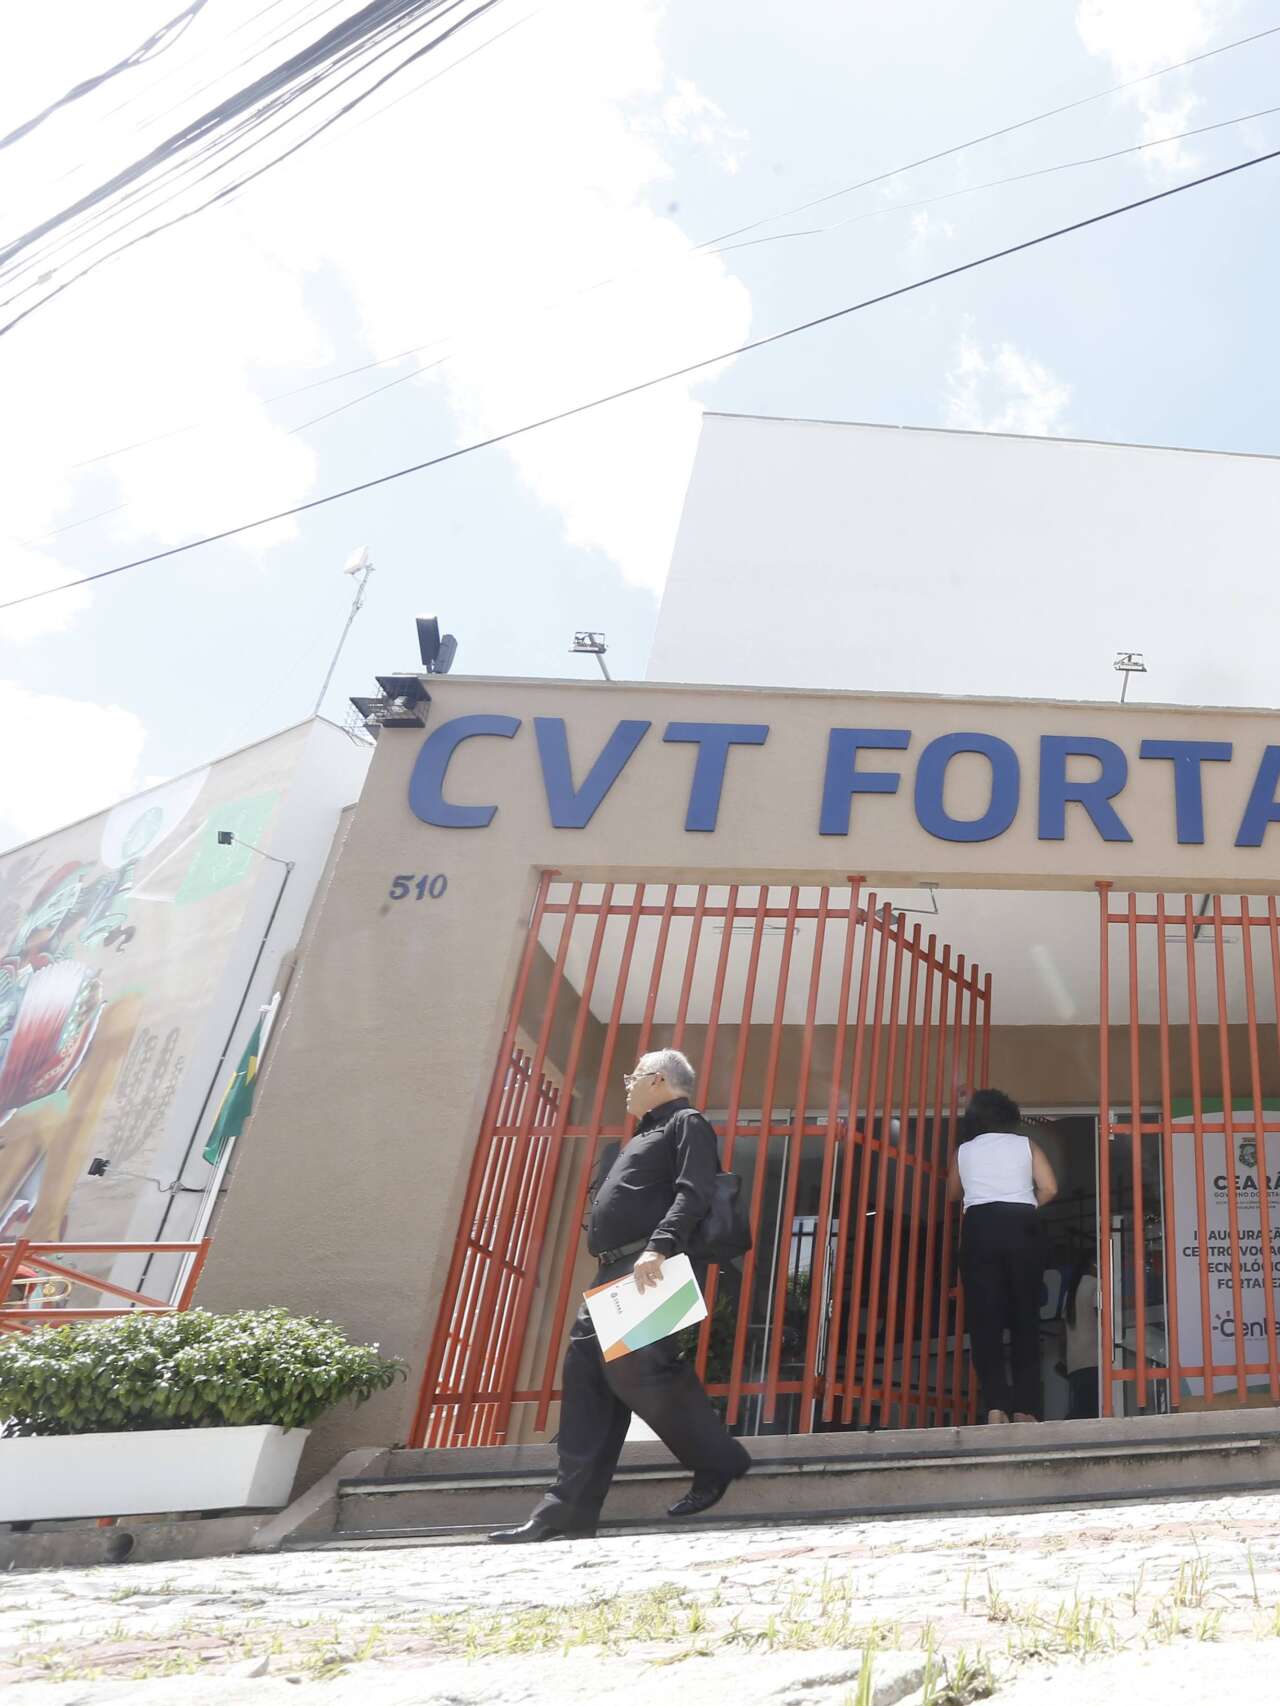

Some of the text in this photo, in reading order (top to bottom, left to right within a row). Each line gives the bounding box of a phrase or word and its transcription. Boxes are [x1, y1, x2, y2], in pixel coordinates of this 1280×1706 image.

[408, 714, 769, 832] CVT
[389, 873, 448, 901] 510
[1182, 1246, 1234, 1257] CETRO
